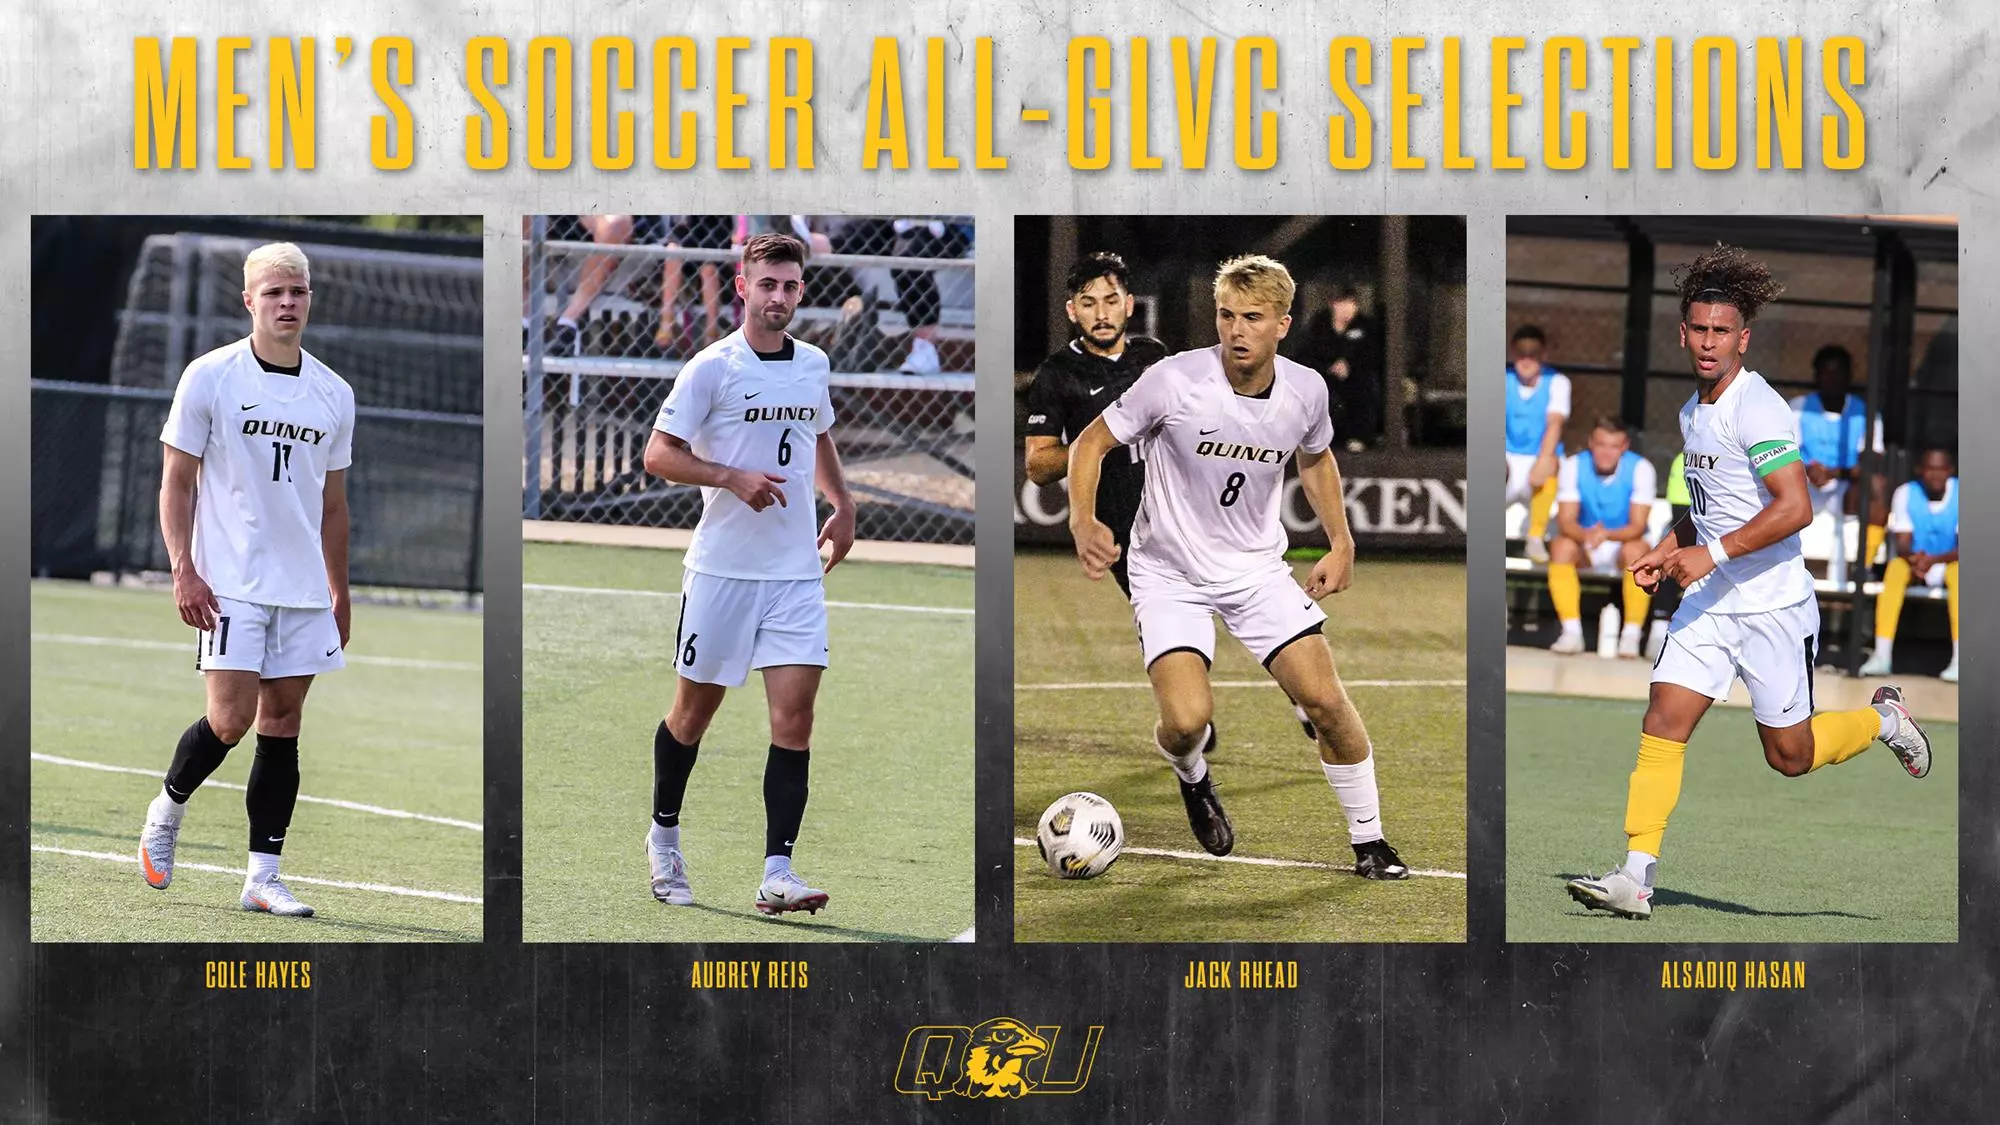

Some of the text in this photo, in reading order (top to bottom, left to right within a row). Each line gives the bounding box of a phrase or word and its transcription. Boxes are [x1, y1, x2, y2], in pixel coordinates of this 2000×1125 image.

[744, 407, 818, 422] QUINCY
[242, 419, 326, 446] QUINCY
[777, 428, 792, 467] 6
[272, 441, 293, 483] 11
[1196, 441, 1289, 464] QUINCY
[1754, 445, 1787, 465] CAPTAIN
[1219, 472, 1246, 507] 8
[682, 632, 699, 667] 6
